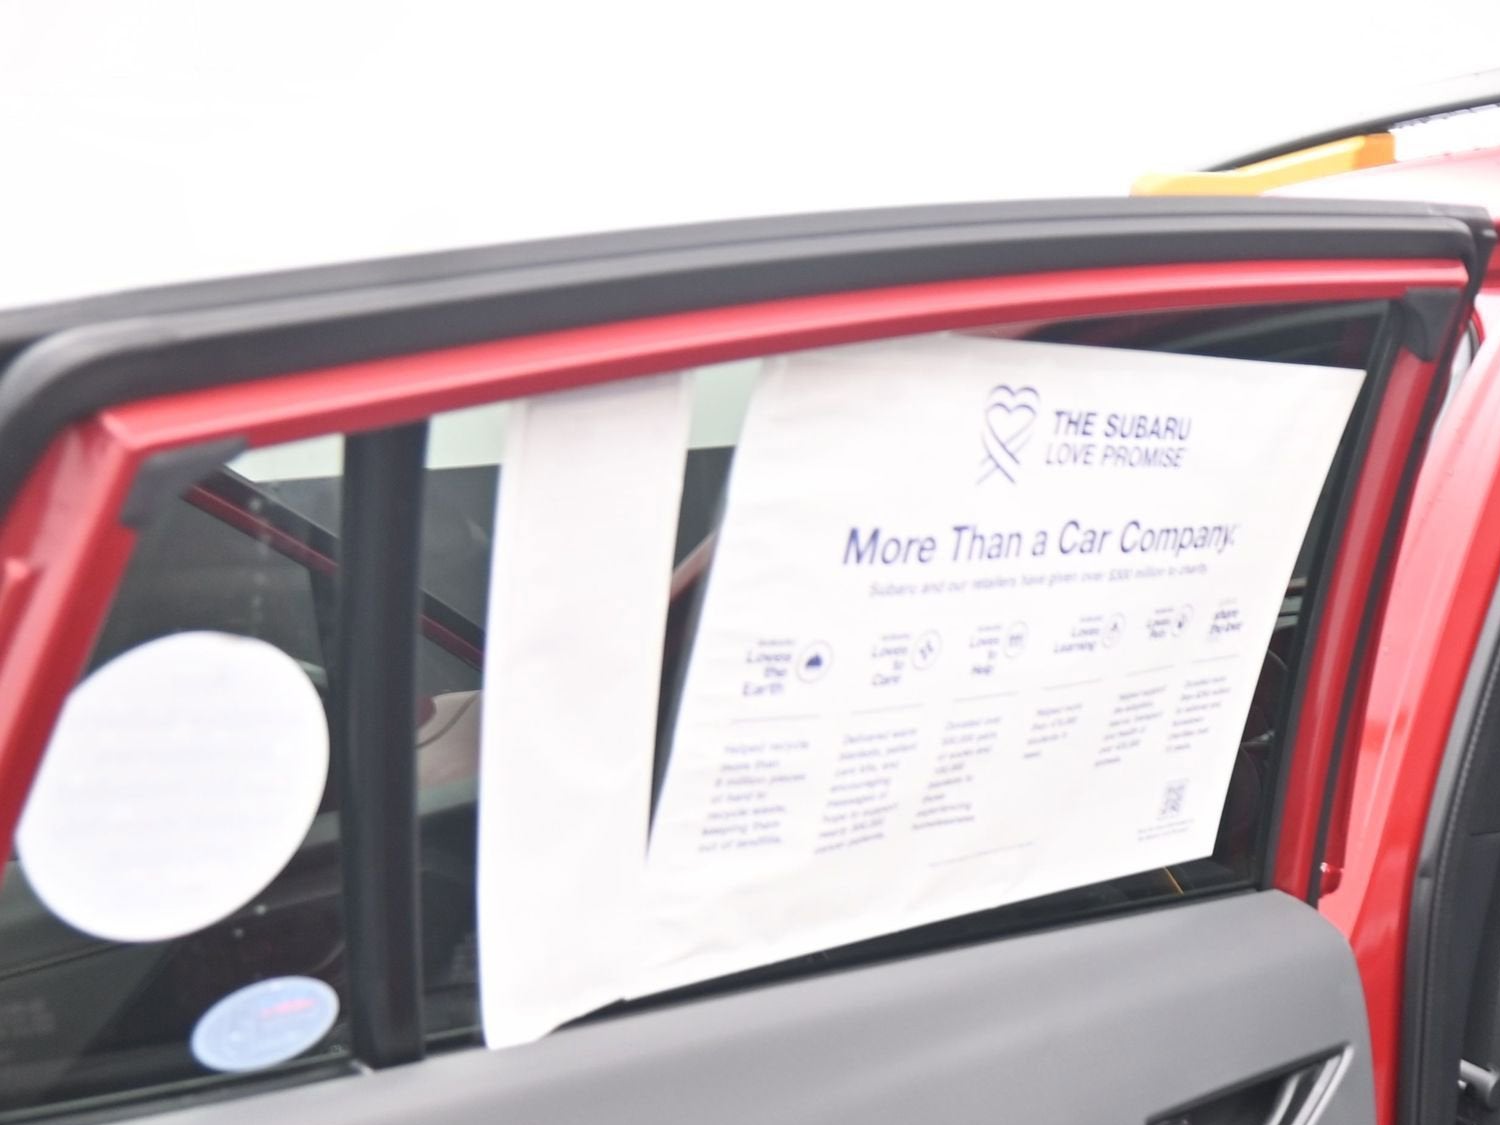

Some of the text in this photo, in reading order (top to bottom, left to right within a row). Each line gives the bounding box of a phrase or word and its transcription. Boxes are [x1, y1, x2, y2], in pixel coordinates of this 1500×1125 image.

[1053, 410, 1192, 441] THE SUBARU
[1045, 443, 1187, 469] LOVE PROMISE
[843, 526, 937, 565] More
[952, 524, 1022, 562] Than
[1030, 529, 1048, 557] a
[1058, 519, 1111, 555] Car
[746, 649, 792, 664] Loves
